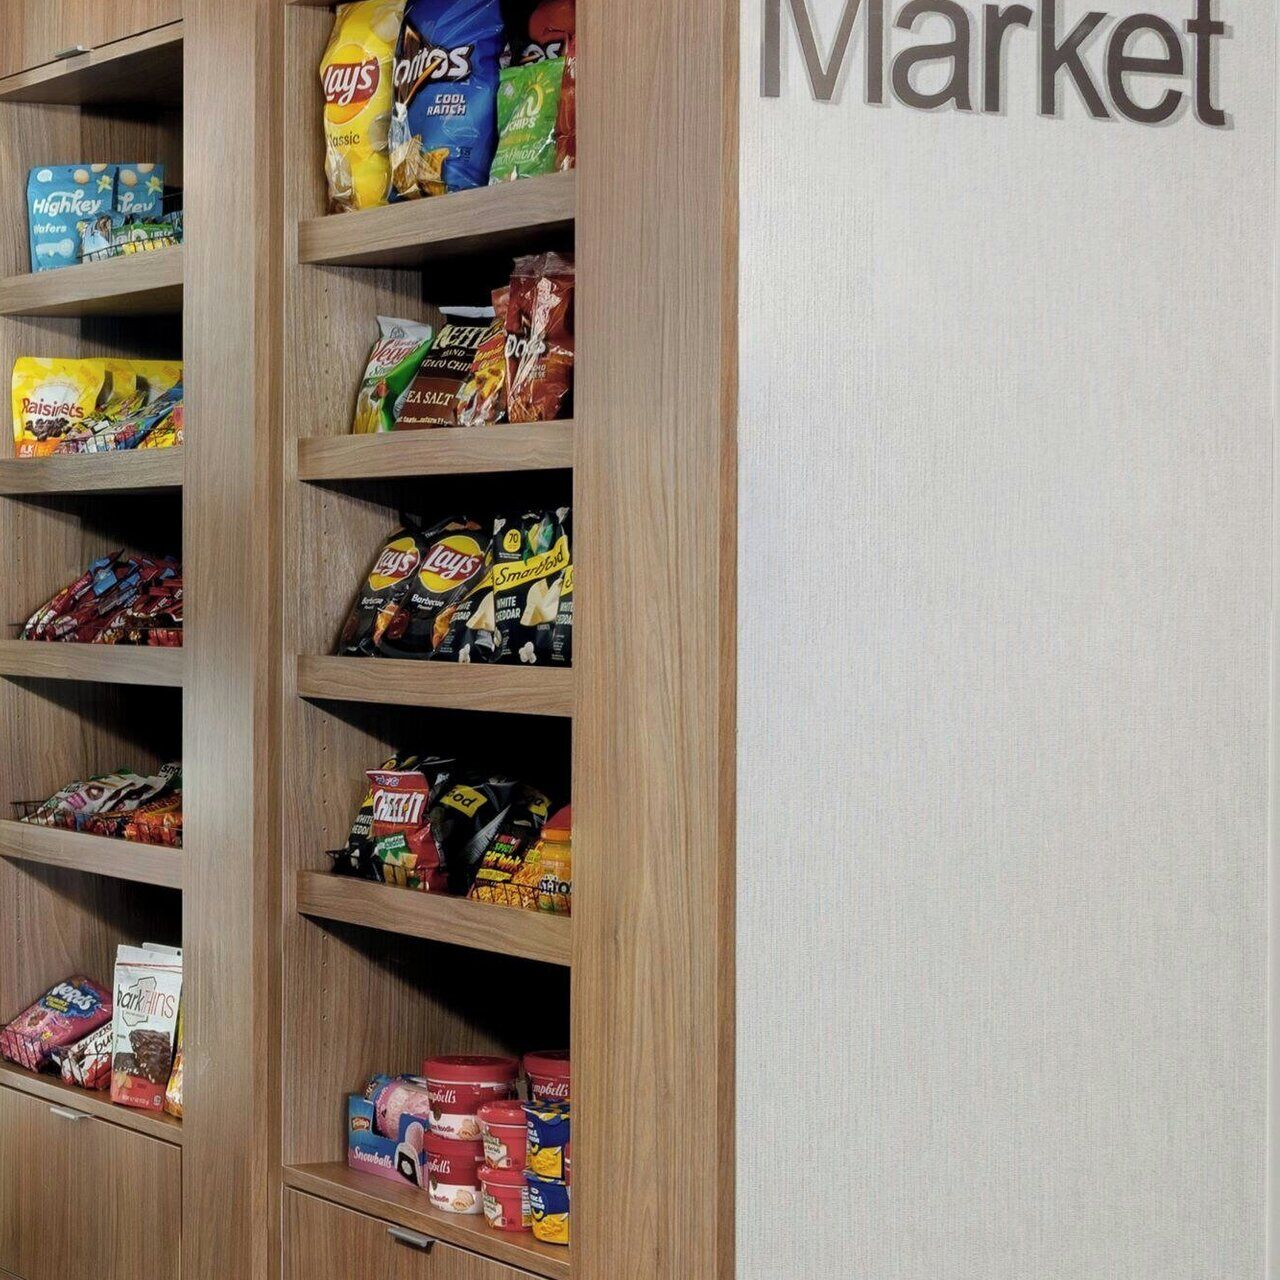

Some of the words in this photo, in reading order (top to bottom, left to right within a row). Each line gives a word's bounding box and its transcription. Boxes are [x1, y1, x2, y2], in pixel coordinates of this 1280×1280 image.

[324, 61, 375, 106] Lay's
[435, 94, 466, 104] COOL
[427, 105, 466, 116] RANCH
[330, 131, 360, 147] lassic
[407, 391, 420, 403] EA
[423, 391, 454, 406] SALT
[22, 397, 84, 419] Raisinets
[508, 533, 518, 543] 70
[372, 548, 416, 576] Lay's
[421, 545, 480, 579] Lay's
[495, 551, 563, 586] Smartfood
[412, 594, 444, 606] Barbecue
[534, 1083, 569, 1097] mpbell's
[354, 1146, 392, 1169] Snowballs
